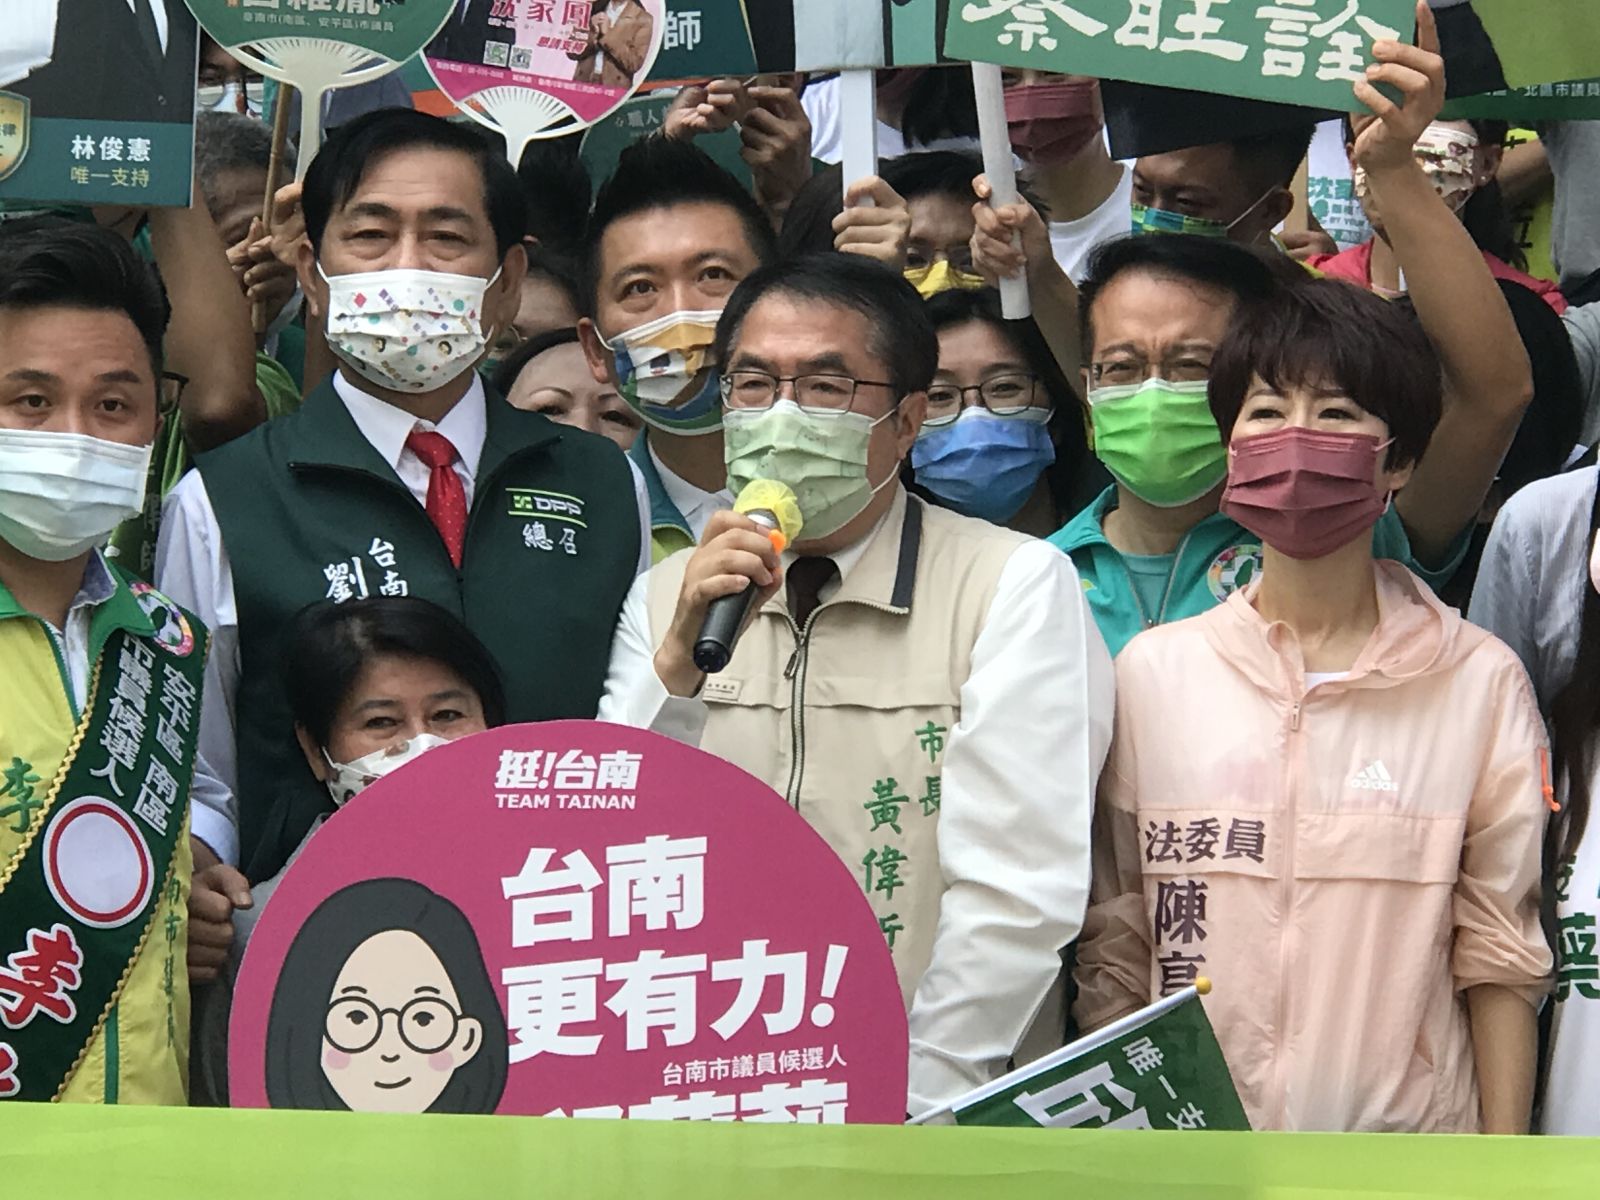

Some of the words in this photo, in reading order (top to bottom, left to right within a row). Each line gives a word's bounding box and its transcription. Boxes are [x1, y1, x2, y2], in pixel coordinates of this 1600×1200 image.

[664, 10, 702, 51] 師
[70, 134, 152, 162] 林俊憲
[70, 165, 151, 188] 唯一支持
[533, 496, 583, 516] DPP
[522, 521, 579, 555] 總召
[322, 555, 370, 605] 劉
[368, 537, 409, 597] 台南
[494, 749, 643, 790] 挺!台南
[914, 720, 948, 817] 市長
[1350, 778, 1399, 792] adidas
[0, 756, 43, 834] 李
[495, 793, 551, 810] TEAM
[557, 793, 637, 811] TAINAN
[1138, 816, 1267, 866] 法委員
[501, 834, 708, 949] 台南
[501, 938, 850, 1065] 更有力!
[662, 1043, 848, 1087] 台南市議員候選人
